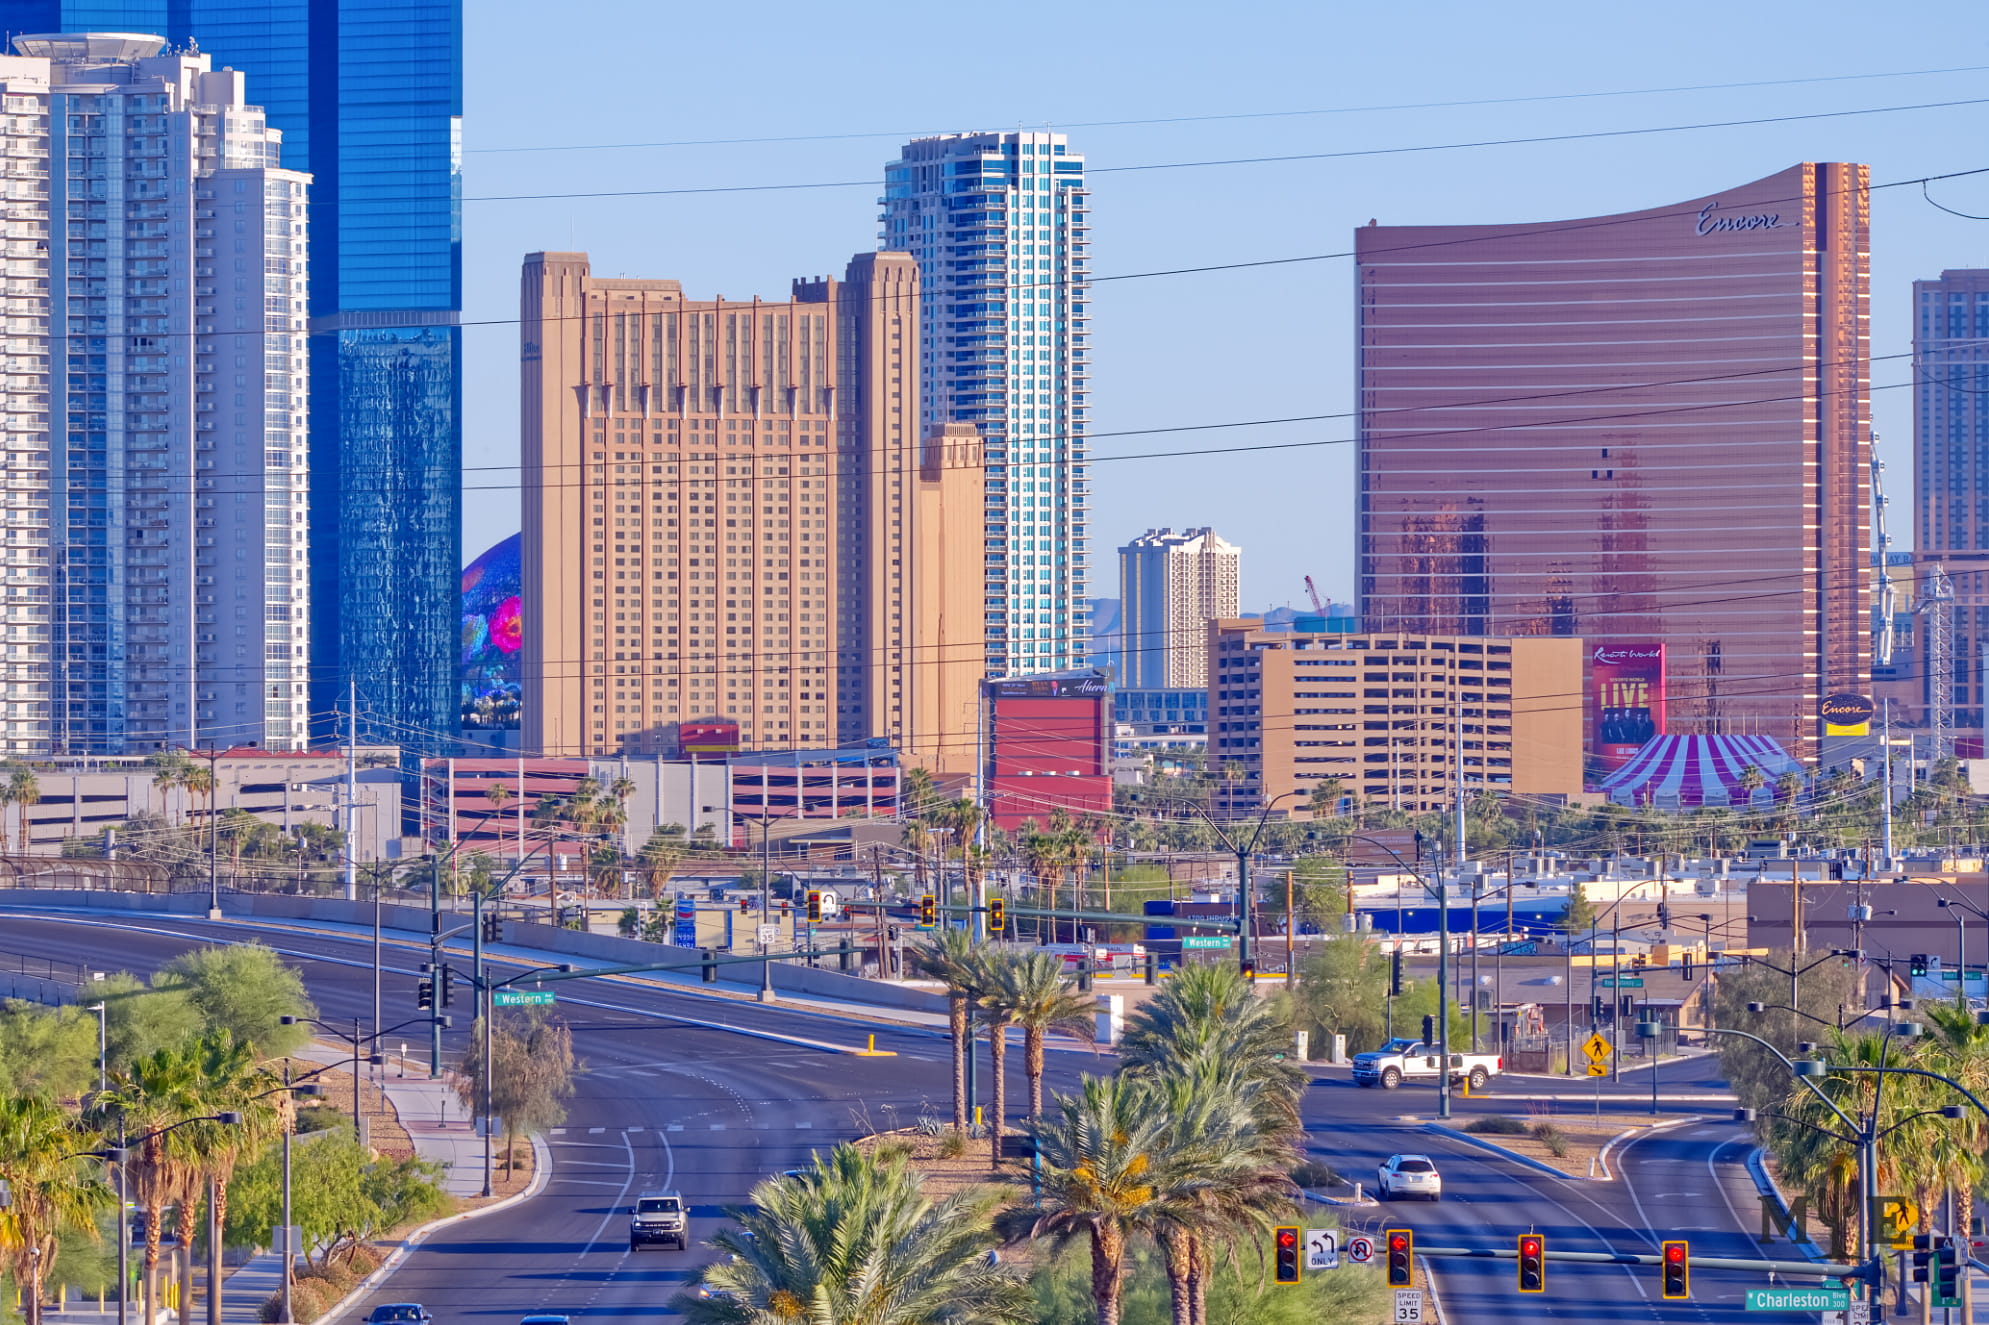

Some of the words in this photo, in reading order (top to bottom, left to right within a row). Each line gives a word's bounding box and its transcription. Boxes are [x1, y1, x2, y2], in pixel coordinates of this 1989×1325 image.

[1696, 202, 1800, 236] Encore
[1074, 680, 1108, 694] Ahern
[1601, 683, 1648, 710] LIVE
[1821, 700, 1872, 715] Encore
[1188, 937, 1221, 947] Western
[502, 994, 541, 1004] Western
[1311, 1257, 1334, 1266] ONLY
[1397, 1292, 1421, 1300] SPEED
[1756, 1292, 1829, 1308] Charleston
[1399, 1308, 1419, 1320] 35
